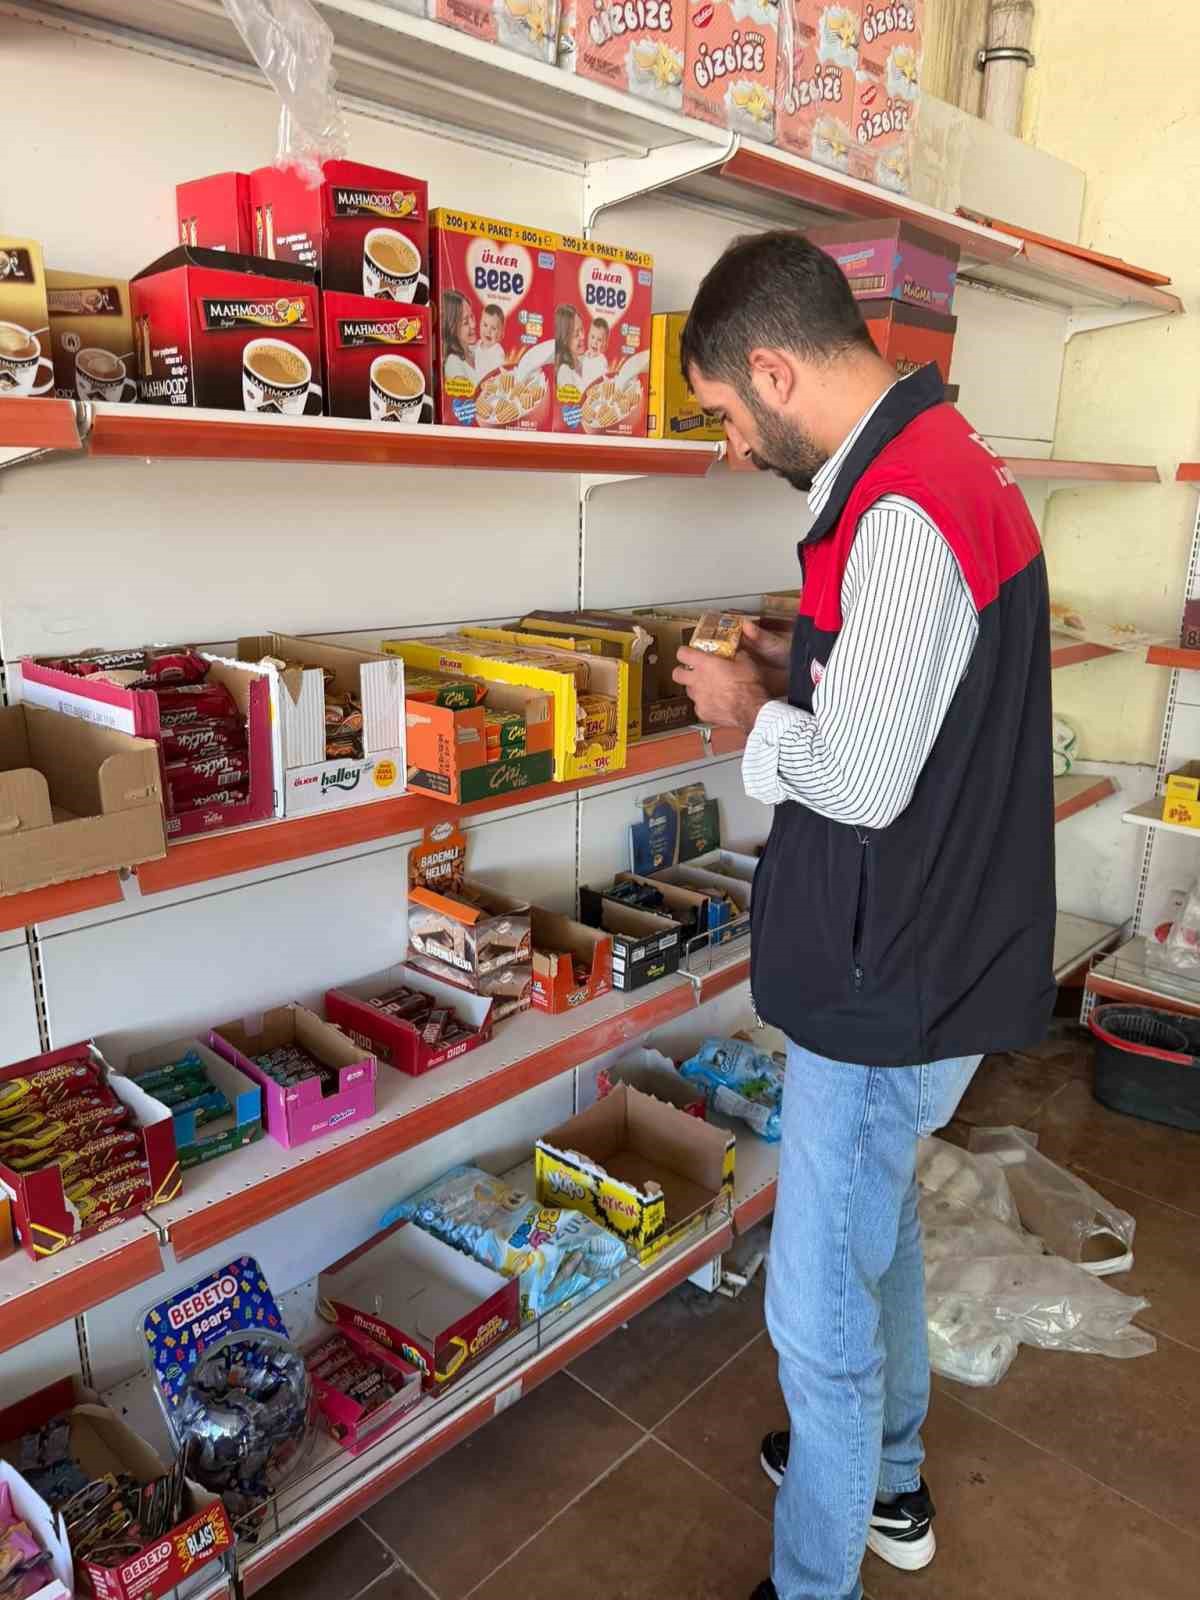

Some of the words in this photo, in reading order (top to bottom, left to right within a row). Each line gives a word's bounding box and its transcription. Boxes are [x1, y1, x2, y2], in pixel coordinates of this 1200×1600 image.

[338, 191, 392, 206] MAHMOOD
[488, 223, 512, 239] PAKET
[482, 248, 519, 269] ÜLKER
[597, 242, 618, 257] PAKET
[591, 267, 623, 285] ÜLKER
[209, 302, 275, 317] MAHMOOD
[343, 322, 398, 337] MAHMOOD
[319, 766, 361, 791] halley
[425, 863, 453, 881] HELVA
[168, 1275, 238, 1329] BEBETO
[191, 1306, 232, 1339] Bears
[186, 1522, 217, 1557] BLAST
[121, 1541, 173, 1585] BEBETO
